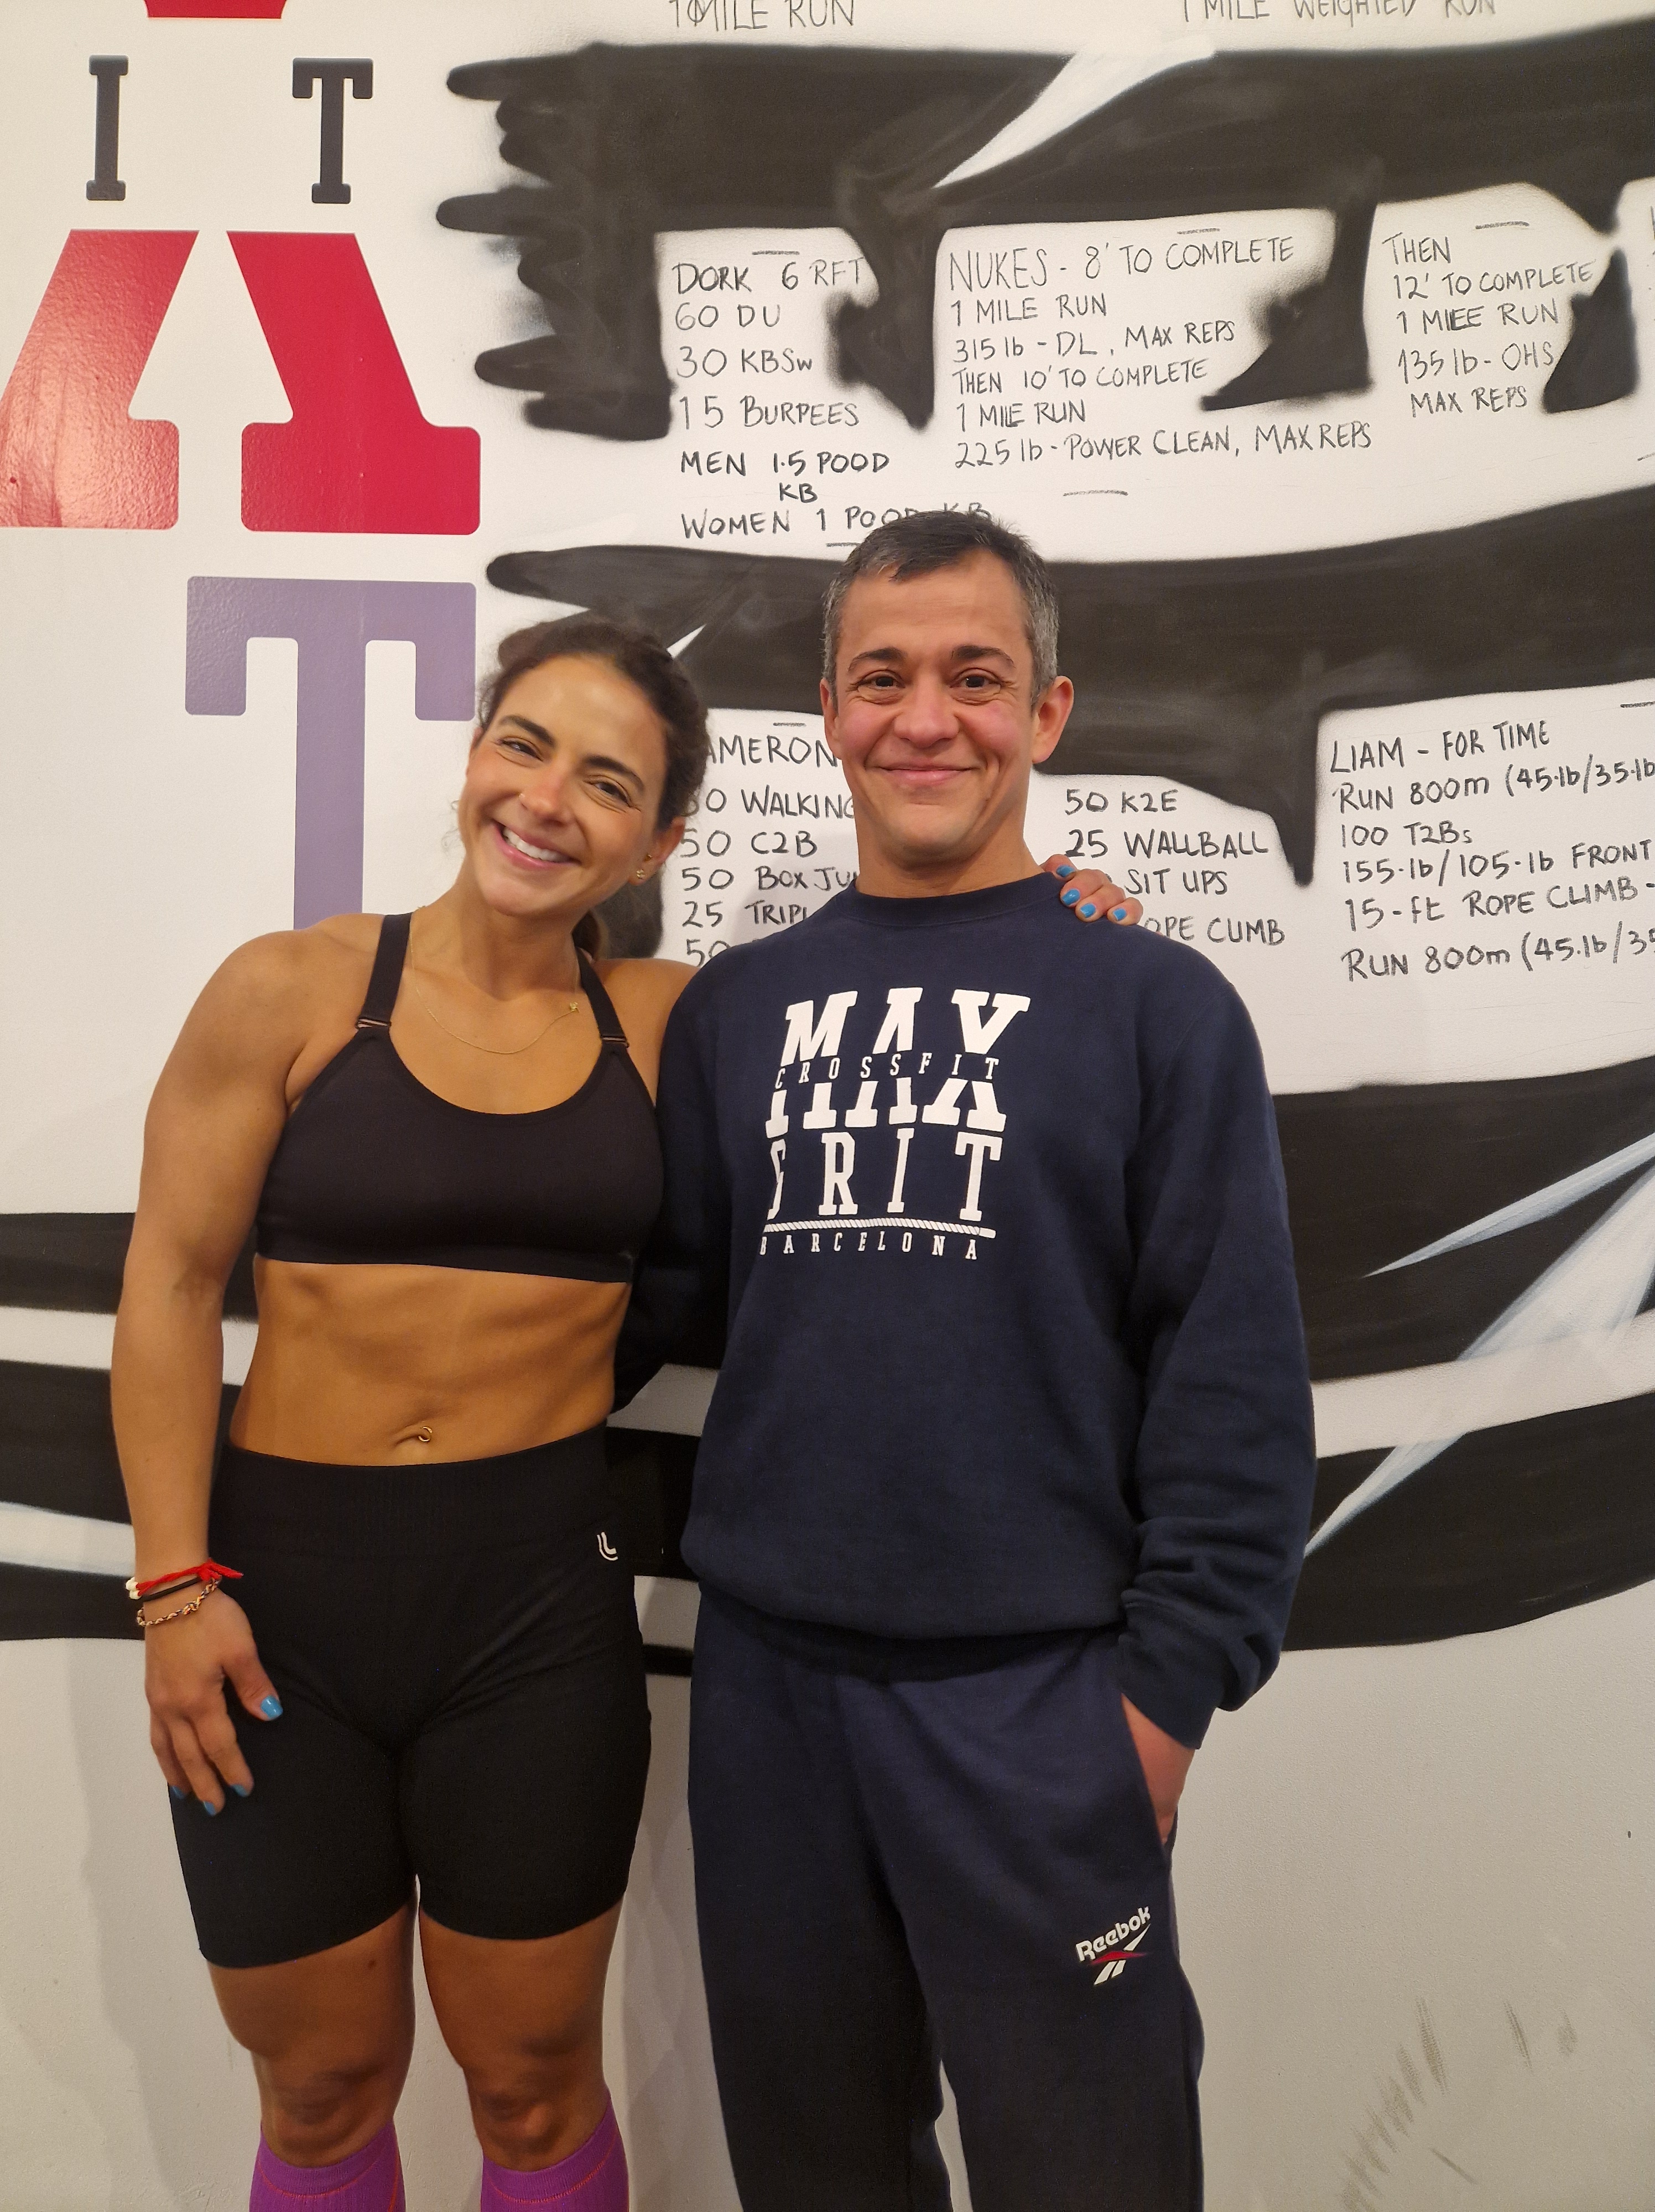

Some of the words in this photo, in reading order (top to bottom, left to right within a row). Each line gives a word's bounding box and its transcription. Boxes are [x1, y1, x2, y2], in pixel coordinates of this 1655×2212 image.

[784, 0, 854, 28] RUN
[950, 247, 1048, 293] NUKES
[1118, 244, 1153, 275] TO
[1165, 236, 1294, 270] COMPLETE
[1381, 232, 1451, 265] THEN
[671, 262, 752, 295] DORK
[781, 261, 799, 290] 6
[812, 254, 867, 286] RFT
[1441, 272, 1472, 296] TO
[1479, 260, 1596, 292] COMPLETE
[675, 301, 719, 331] 60
[737, 304, 780, 328] DU
[950, 300, 961, 327] 1
[976, 297, 1038, 325] MILE
[1055, 293, 1107, 319] RUN
[1396, 310, 1408, 335] 1
[1497, 298, 1559, 326] RUN
[953, 337, 996, 363] 315
[1125, 325, 1173, 349] MAX
[1184, 320, 1235, 345] REPS
[676, 345, 727, 379] 30
[951, 367, 1002, 395] THEN
[1058, 367, 1087, 389] TO
[1096, 358, 1208, 388] COMPLETE
[1398, 348, 1444, 385] 135
[1502, 341, 1555, 371] OHS
[679, 395, 724, 430] 15
[740, 395, 860, 427] BURPEES
[956, 403, 966, 432] 1
[1033, 399, 1086, 425] RUN
[1410, 390, 1463, 418] MAX
[1471, 385, 1528, 413] REPS
[955, 439, 1010, 469] 225
[1063, 433, 1142, 461] POWER
[1153, 425, 1240, 457] CLEAN,
[1255, 424, 1314, 455] MAX
[1319, 420, 1372, 449] REPS
[680, 451, 746, 477] MEN
[773, 450, 806, 477] 1.5
[816, 451, 890, 475] POOD
[779, 482, 818, 504] KB
[681, 508, 790, 539] WOMEN
[816, 508, 826, 531] 1
[1329, 737, 1405, 774] LIAM
[1442, 729, 1485, 761] FOR
[1492, 719, 1550, 751] TIME
[1064, 788, 1109, 816] 50
[1121, 789, 1179, 814] K2E
[1331, 782, 1394, 815] RUN
[1409, 776, 1490, 806] 800m
[680, 828, 732, 858] 50
[751, 830, 818, 858] C2B
[1065, 829, 1108, 858] 25
[1123, 828, 1269, 859] WALLBALL
[1341, 824, 1389, 848] 100
[1571, 838, 1652, 869] FRONT
[681, 867, 735, 891] 50
[754, 865, 809, 891] BOX
[814, 867, 858, 891] JU
[1124, 868, 1171, 895] SIT
[1182, 869, 1228, 895] UPS
[1461, 889, 1536, 917] ROPE
[1546, 875, 1638, 909] CLIMB
[682, 901, 724, 928] 25
[1340, 948, 1409, 982] RUN
[1424, 945, 1511, 974] 800m
[775, 1052, 999, 1089] CROSSFIT
[759, 1231, 977, 1260] BARCELONA
[1076, 1906, 1151, 1961] Reebok
